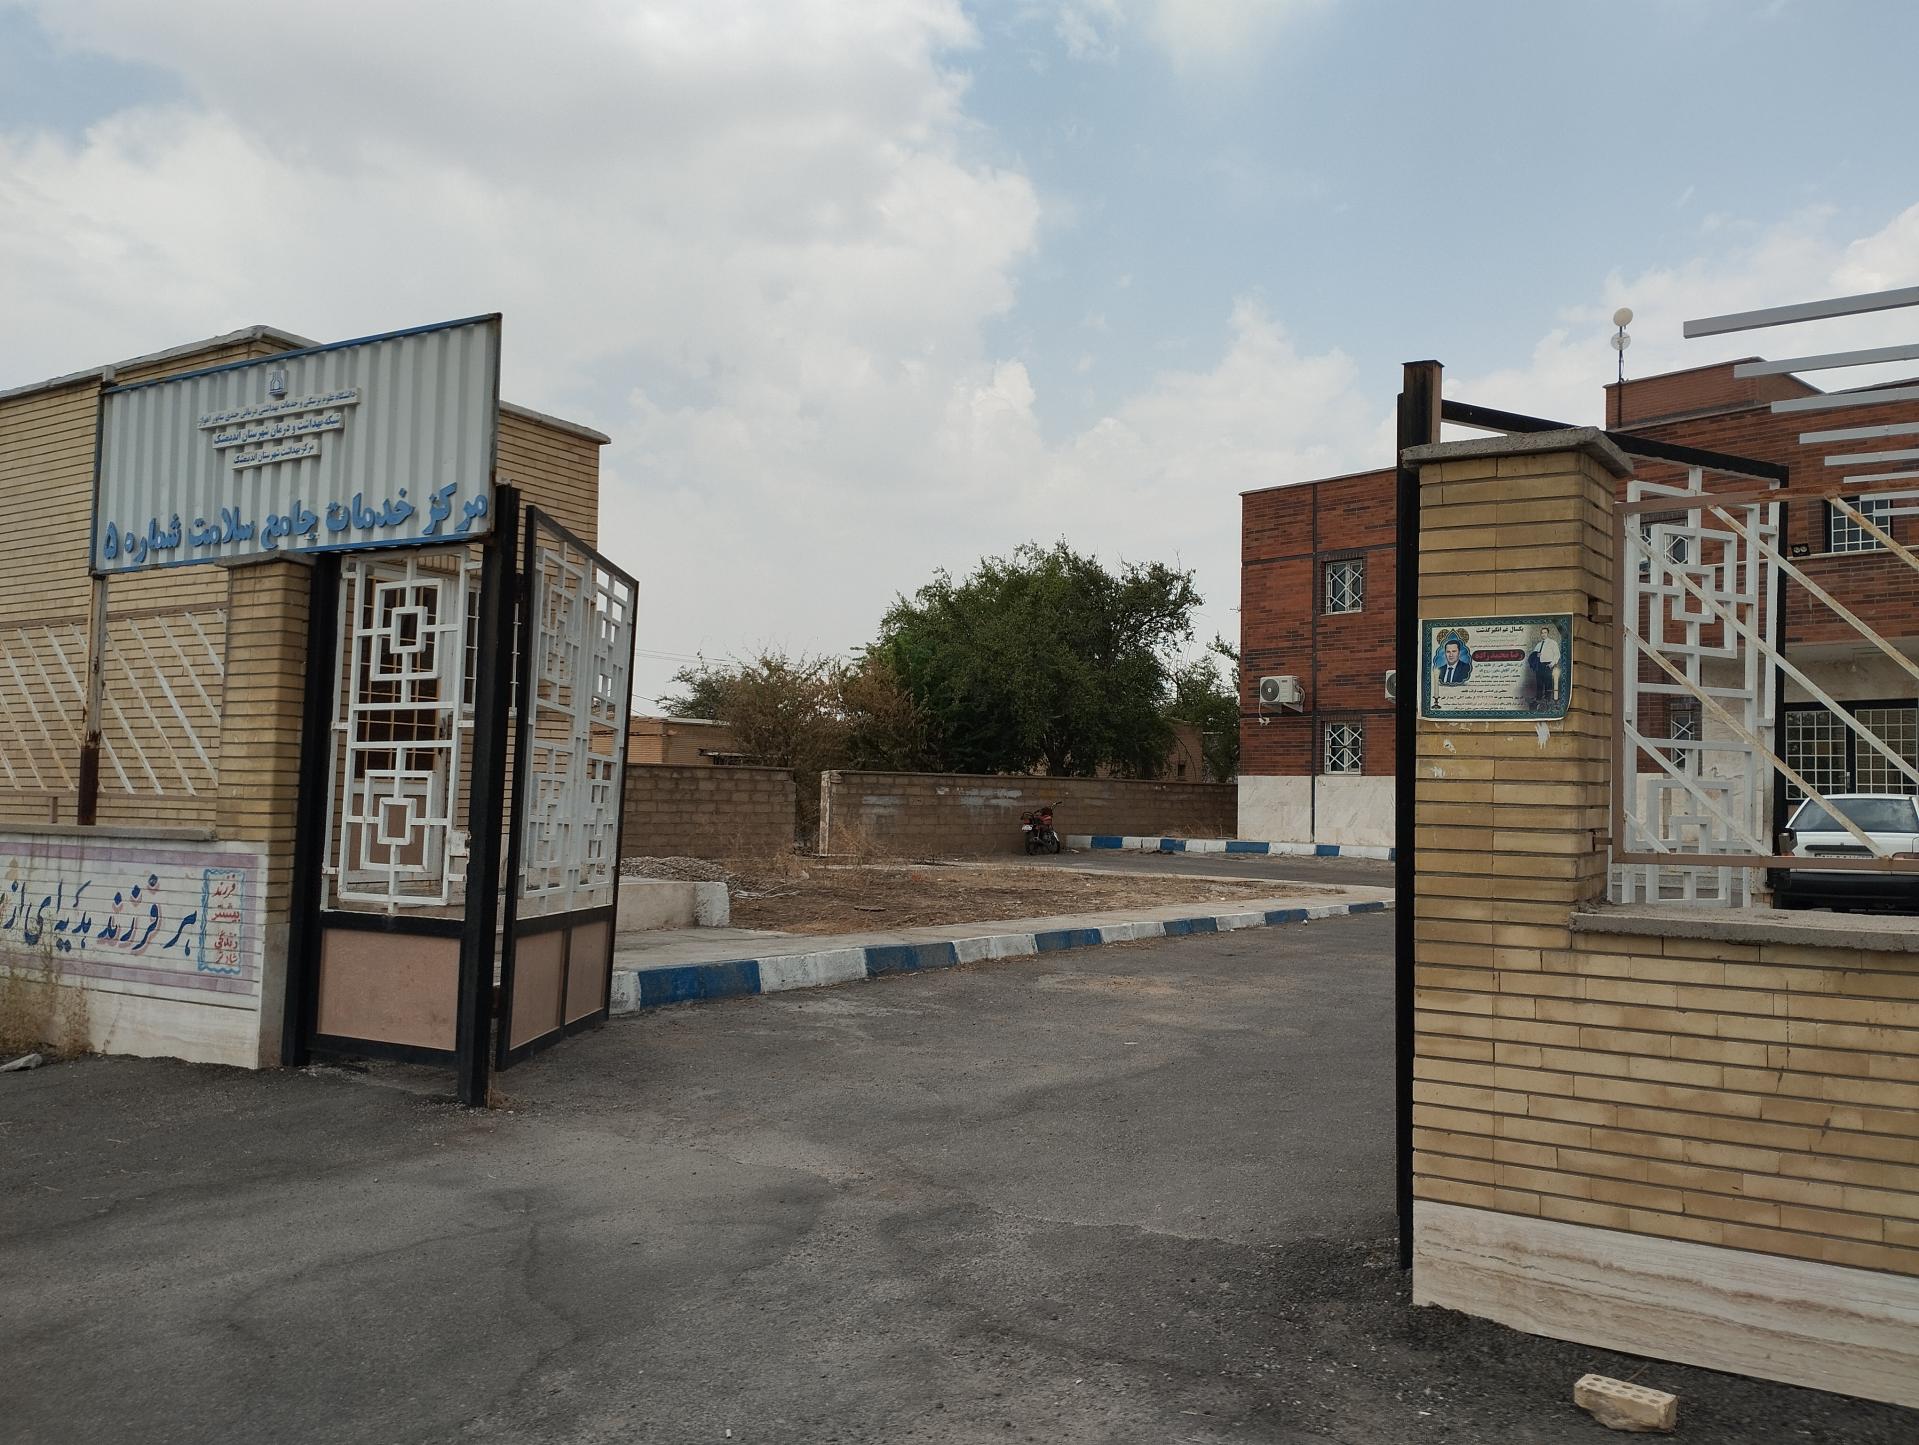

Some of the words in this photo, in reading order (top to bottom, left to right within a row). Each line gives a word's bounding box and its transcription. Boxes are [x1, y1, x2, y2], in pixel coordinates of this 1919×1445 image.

[242, 426, 269, 442] شهرستان
[270, 423, 290, 438] درمان
[297, 417, 325, 431] بهداشت
[187, 507, 256, 549] سلامت
[260, 500, 319, 550] جامع
[325, 488, 415, 533] خدمات
[423, 482, 489, 536] مرکز
[102, 520, 119, 561] ۵
[124, 513, 182, 564] شماره
[210, 873, 236, 898] فرزند
[97, 873, 160, 951] فرزند
[162, 909, 197, 957] هر
[211, 903, 240, 923] بیشتر
